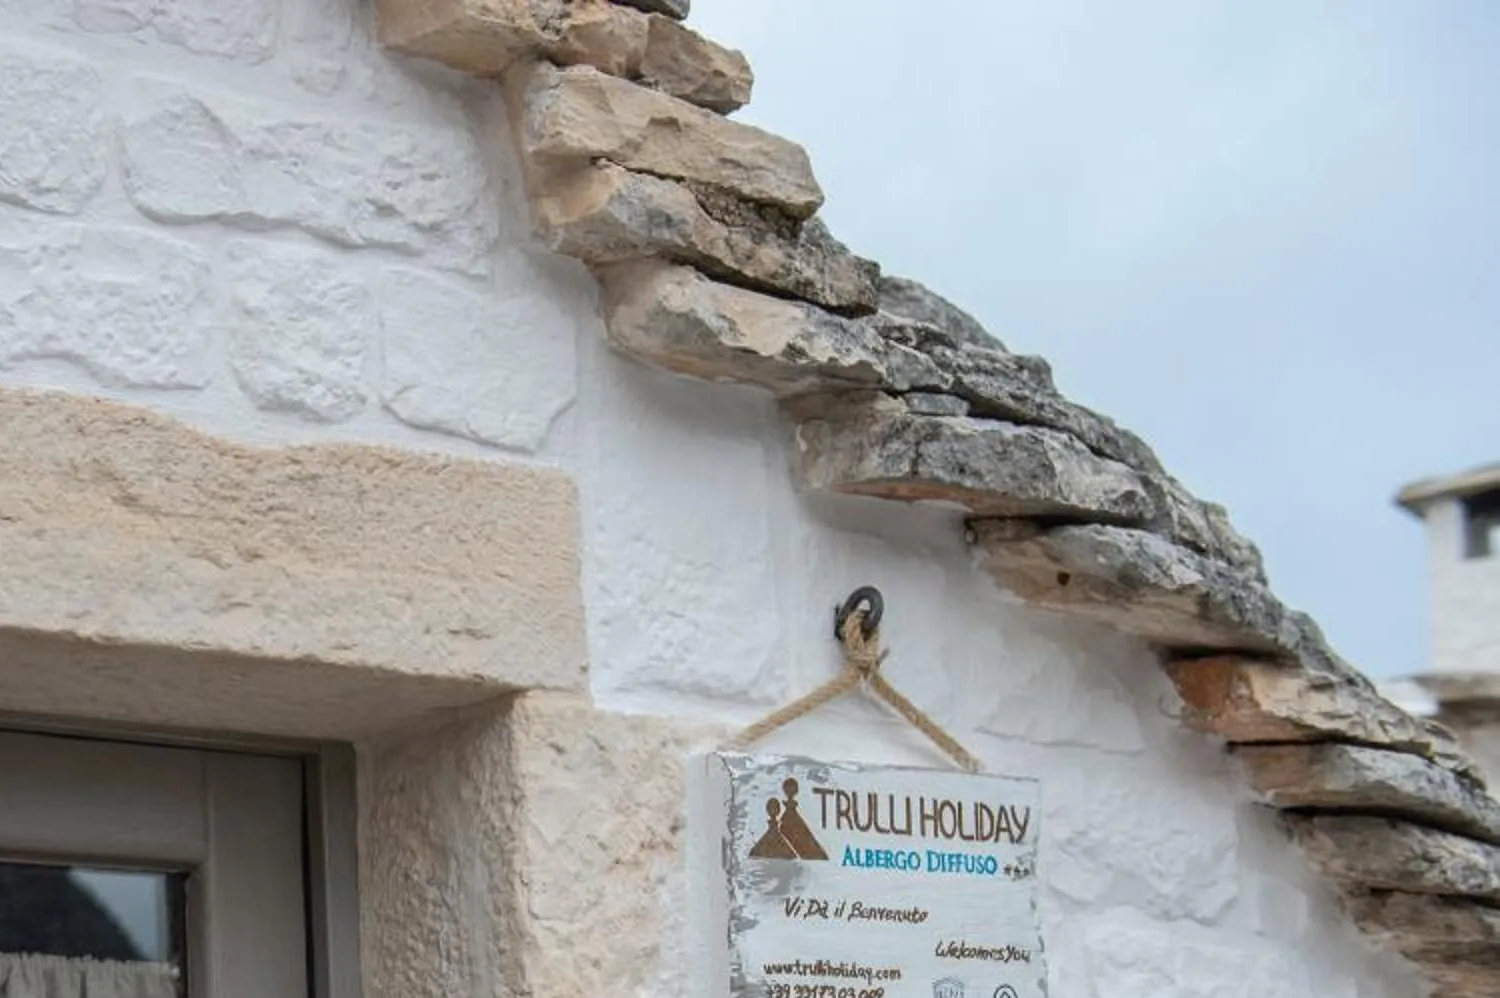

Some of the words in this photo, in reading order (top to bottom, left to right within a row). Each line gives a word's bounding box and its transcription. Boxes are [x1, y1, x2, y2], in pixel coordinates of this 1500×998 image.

[812, 787, 912, 836] TRULLI
[919, 796, 1030, 844] HOLIDAY
[841, 844, 921, 871] ALBERGO
[927, 850, 997, 876] DIFFUSO
[834, 900, 846, 918] il
